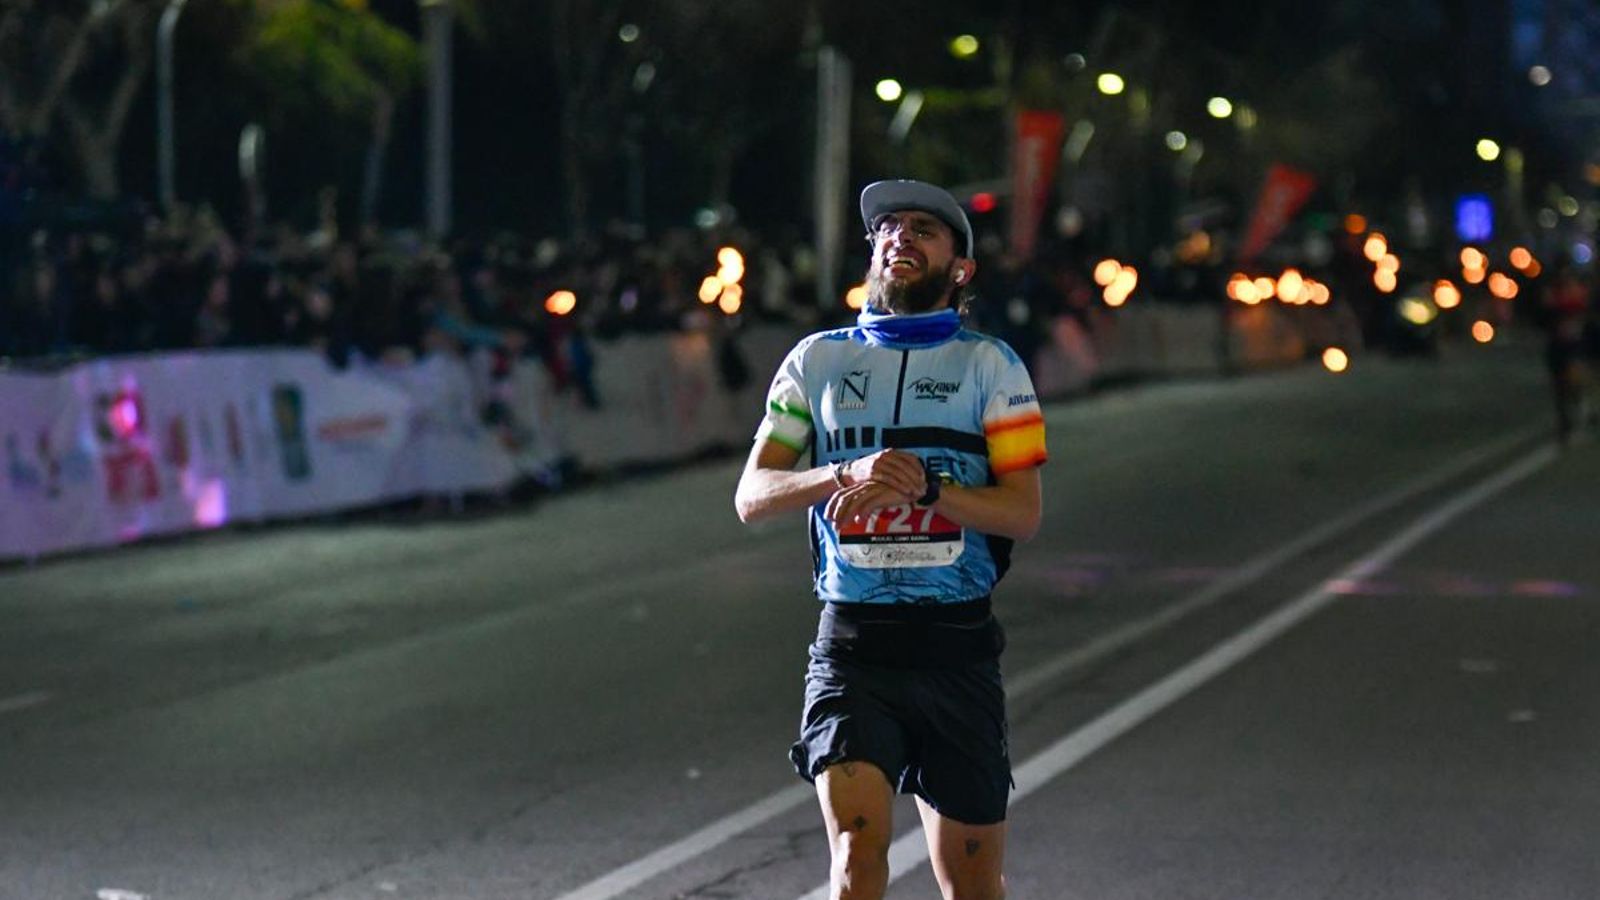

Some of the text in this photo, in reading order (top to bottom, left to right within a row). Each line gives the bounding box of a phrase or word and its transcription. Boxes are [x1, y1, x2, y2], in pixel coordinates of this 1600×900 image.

[840, 371, 868, 404] Ñ
[1008, 393, 1037, 407] Allian
[864, 503, 935, 534] 727
